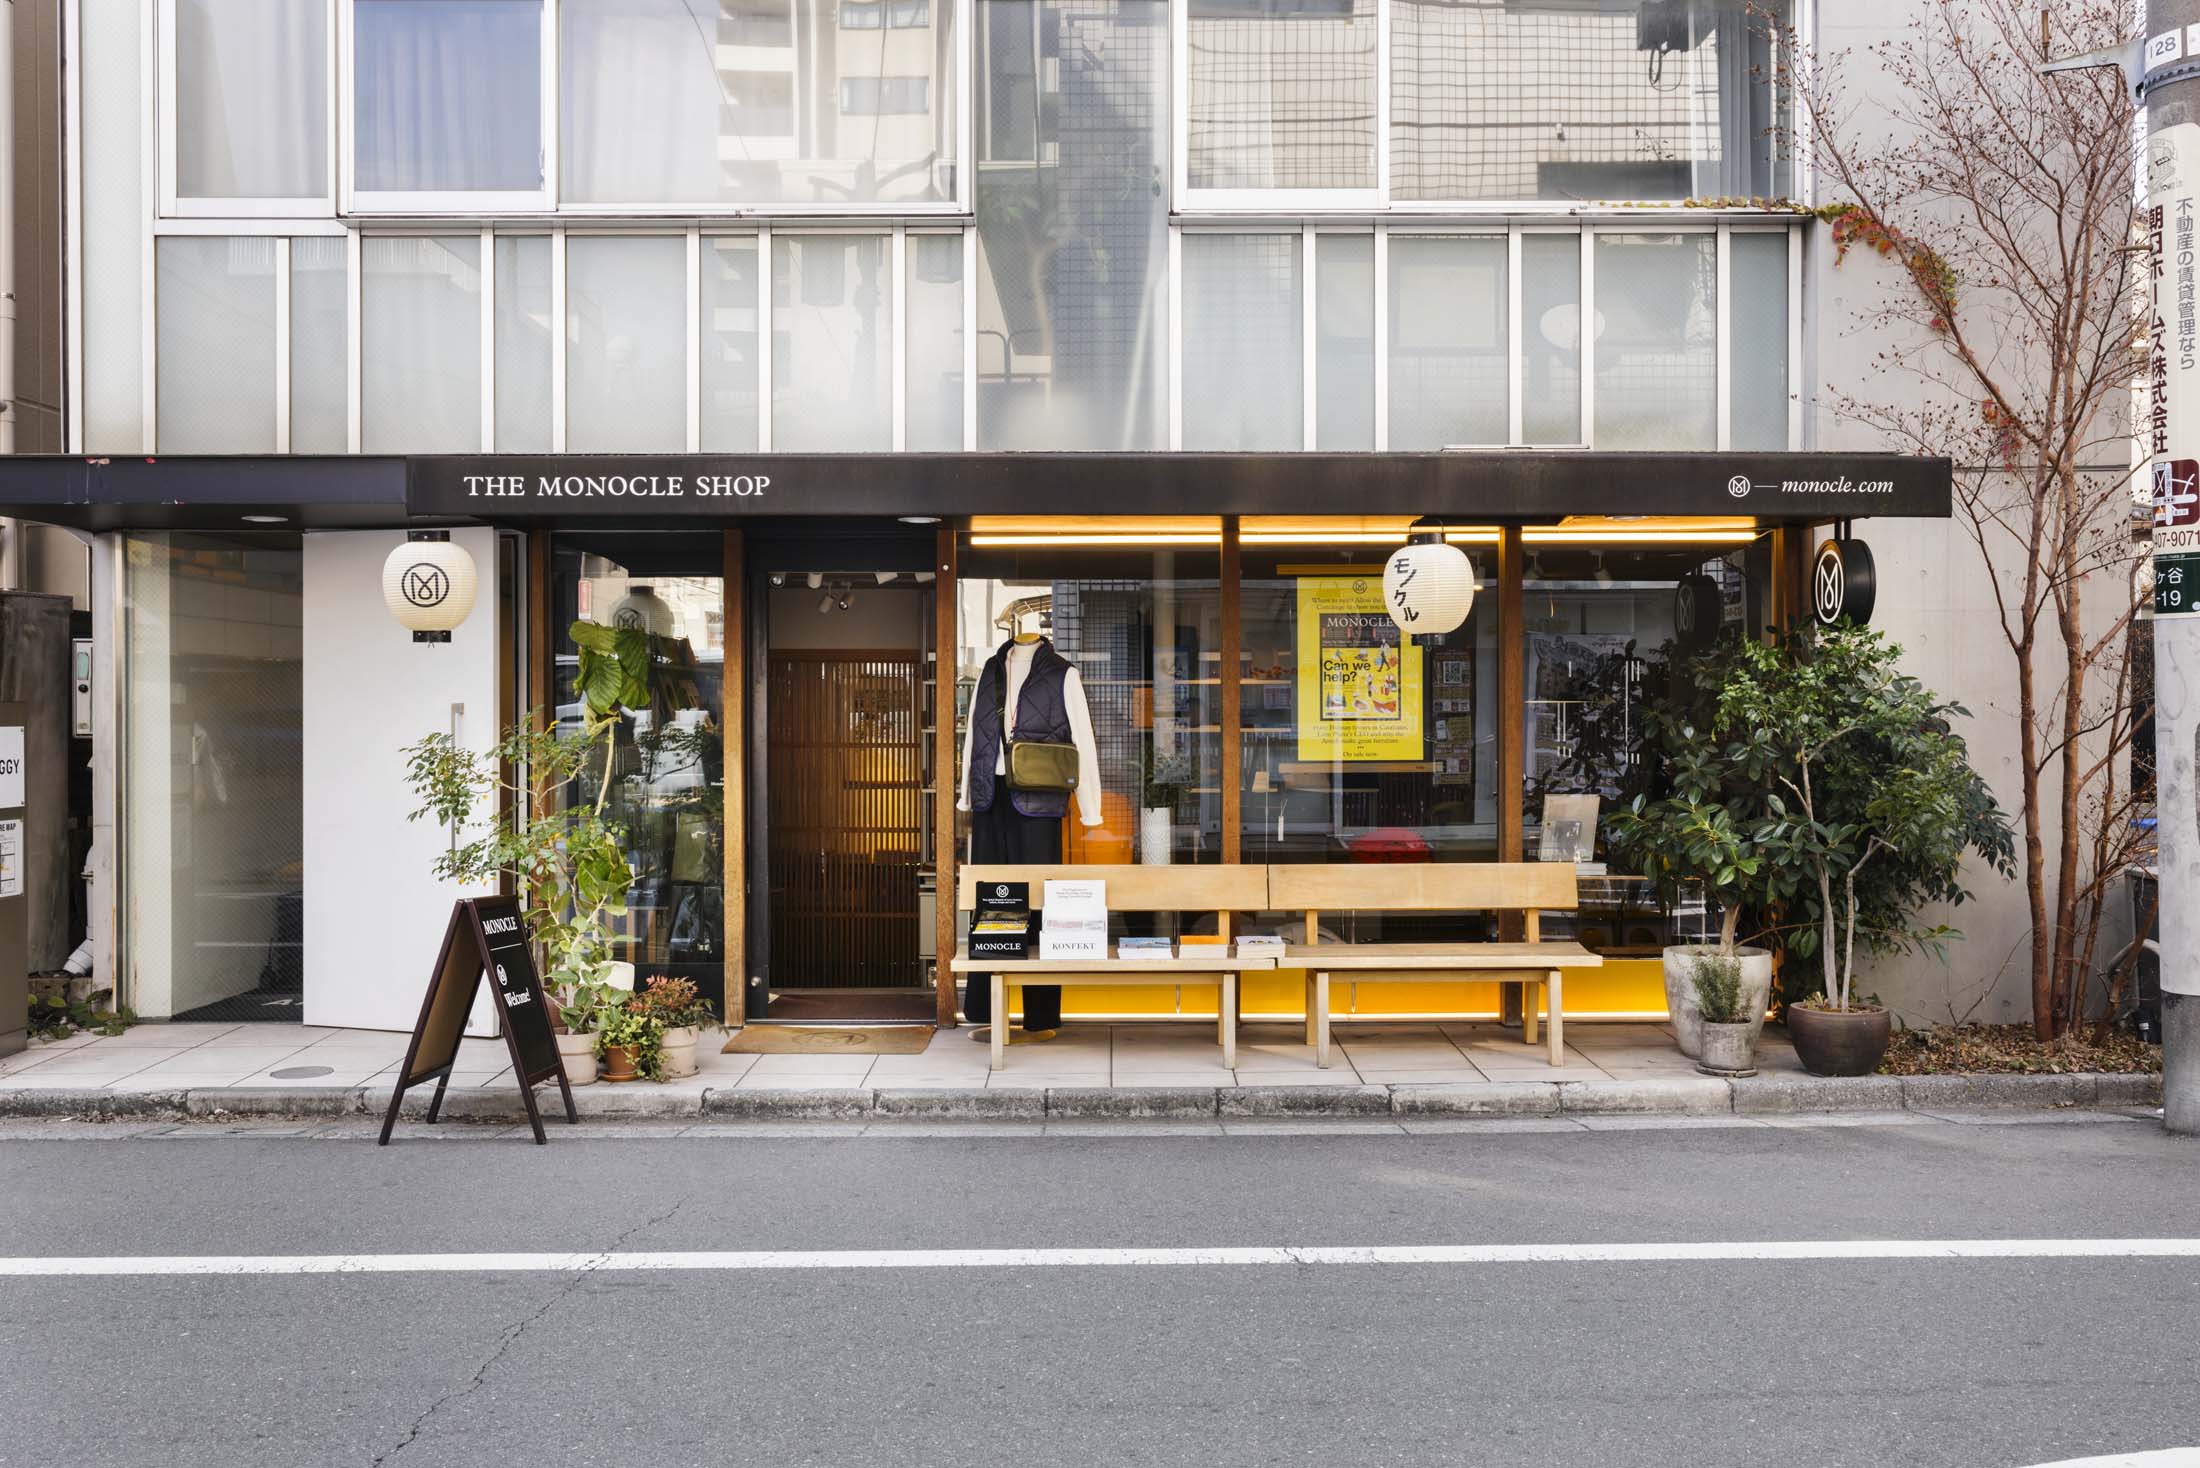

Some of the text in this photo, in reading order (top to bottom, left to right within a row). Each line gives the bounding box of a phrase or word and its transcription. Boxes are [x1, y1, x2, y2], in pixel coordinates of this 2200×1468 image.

[2176, 197, 2196, 371] 不動産の賃貸管理なら
[2149, 204, 2168, 455] 朝日ホームズ株式会社
[463, 476, 771, 496] THE MONOCLE SHOP
[1781, 475, 1894, 494] monocle.com
[1394, 558, 1420, 622] モノクル
[1327, 617, 1394, 628] MONOCLE
[1324, 661, 1371, 671] Can we
[1324, 672, 1357, 684] help?
[482, 916, 518, 935] MONOCLE
[975, 943, 1021, 951] MONOCLE
[504, 987, 532, 1008] Welcome!
